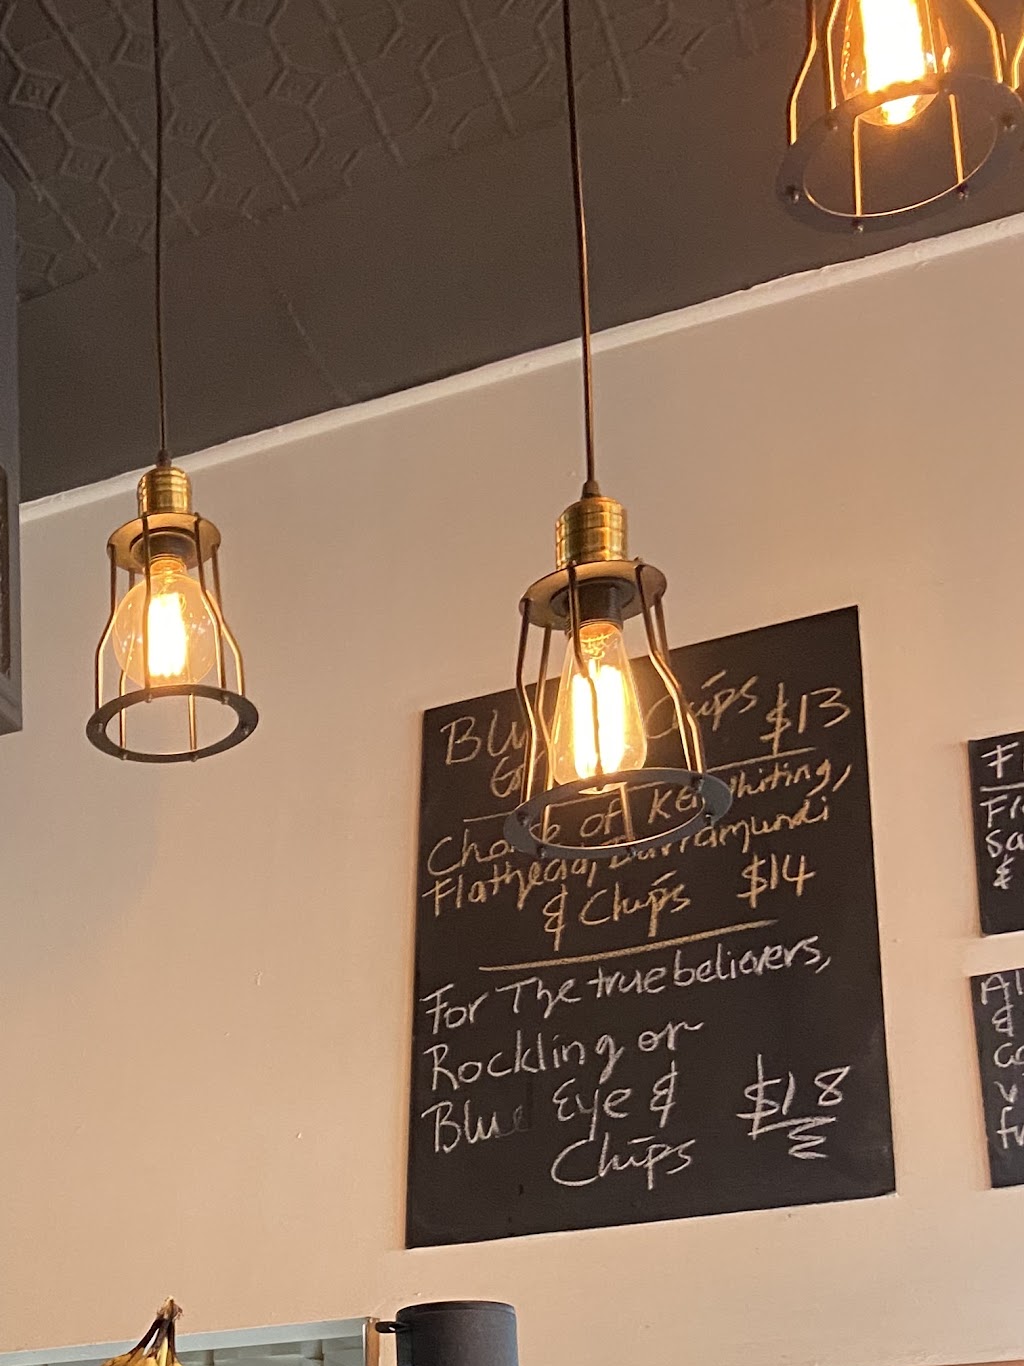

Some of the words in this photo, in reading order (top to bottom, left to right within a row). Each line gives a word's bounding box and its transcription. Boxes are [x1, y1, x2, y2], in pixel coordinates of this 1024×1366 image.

[759, 682, 852, 756] $13
[580, 798, 624, 838] of
[542, 883, 568, 951] &
[579, 861, 690, 938] Chips
[736, 853, 817, 908] $14
[419, 983, 489, 1035] For
[495, 976, 582, 1018] The
[423, 1029, 625, 1085] Rockling
[637, 1021, 704, 1051] or
[551, 1078, 632, 1141] Eye
[649, 1060, 678, 1129] &
[736, 1054, 851, 1140] $18
[550, 1132, 696, 1190] Chips
